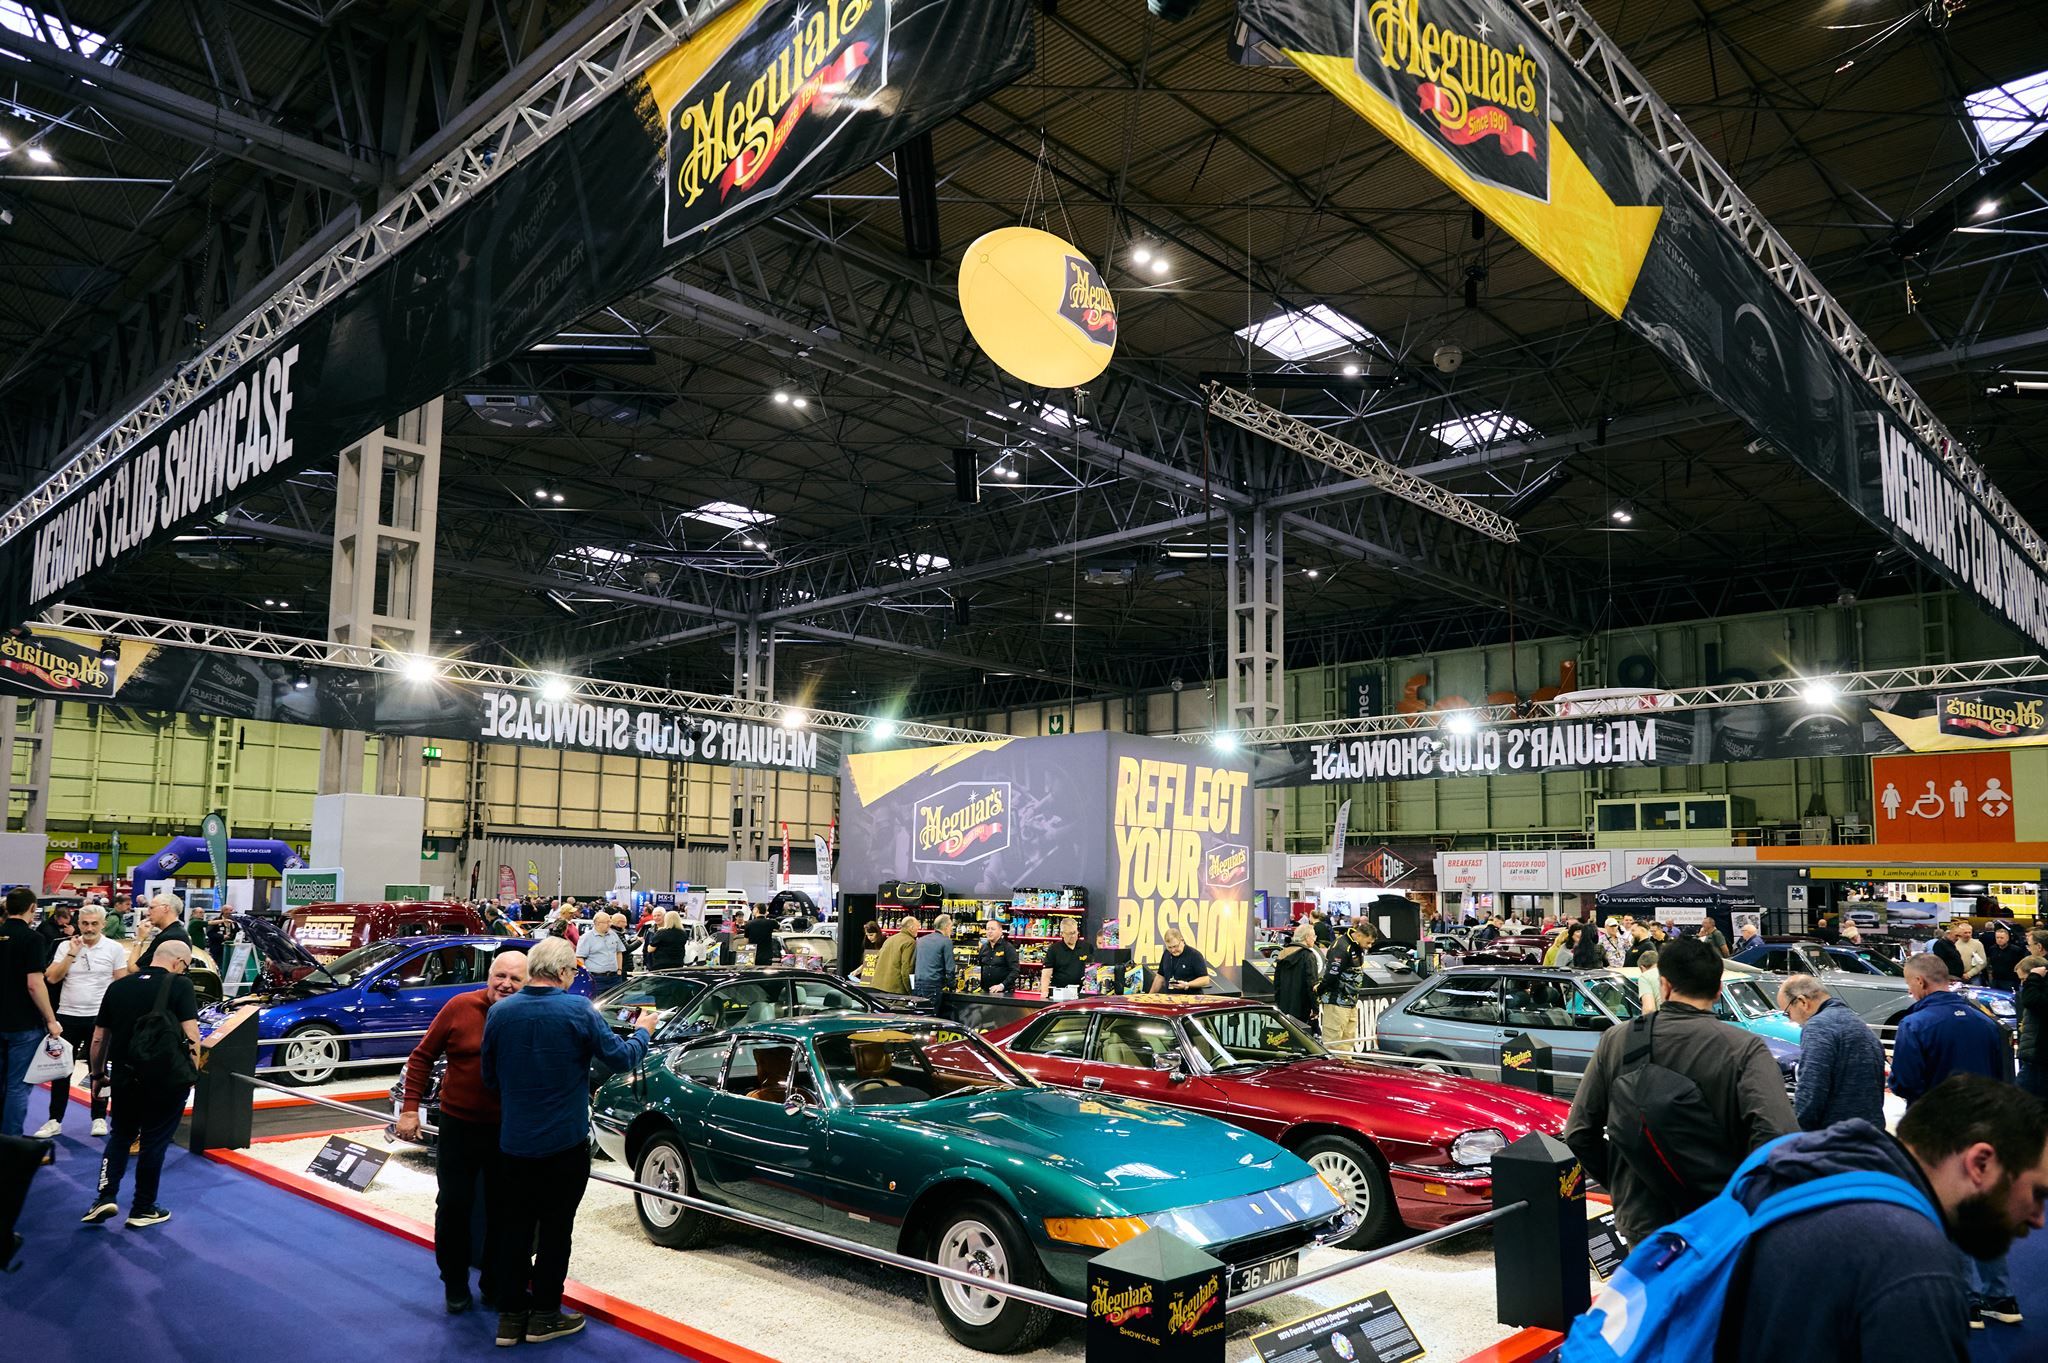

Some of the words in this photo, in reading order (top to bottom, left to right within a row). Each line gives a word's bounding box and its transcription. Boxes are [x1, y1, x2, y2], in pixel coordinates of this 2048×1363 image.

[773, 108, 800, 151] Since
[1468, 114, 1490, 136] Since
[1489, 110, 1508, 134] 1901
[30, 477, 110, 605] MEGUIAR'S
[110, 444, 160, 559] CLUB
[160, 344, 300, 530] SHOWCASE
[1877, 412, 1969, 584] MEGUIAR'S
[1970, 504, 2002, 610] CLUB
[1115, 756, 1249, 835] REFLECT
[919, 787, 1003, 854] Meguiar's
[1115, 825, 1202, 899] YOUR
[1292, 864, 1325, 879] HUNGRY?
[1364, 853, 1384, 883] THE
[1383, 851, 1405, 884] EDGE
[1448, 859, 1483, 868] BREAKFAST
[1530, 860, 1546, 868] FOOD
[1565, 861, 1607, 879] HUNGRY?
[1636, 857, 1656, 866] DINE
[1882, 869, 1928, 878] Lamborghini
[1928, 869, 1947, 877] Club
[1947, 869, 1961, 877] UK
[1611, 895, 1714, 904] www.mercedes-benz-club.co.uk
[1117, 898, 1249, 969] PASSION
[1097, 1277, 1110, 1287] THE
[1241, 1266, 1261, 1292] 36
[1262, 1257, 1290, 1285] JMY
[1091, 1282, 1153, 1323] Meguiar's
[1168, 1274, 1219, 1336] Meguiar's
[1173, 1291, 1184, 1299] THE
[1120, 1326, 1161, 1346] SHOWCASE
[1192, 1321, 1225, 1338] SHOWCASE
[1289, 1323, 1308, 1336] Ferrari
